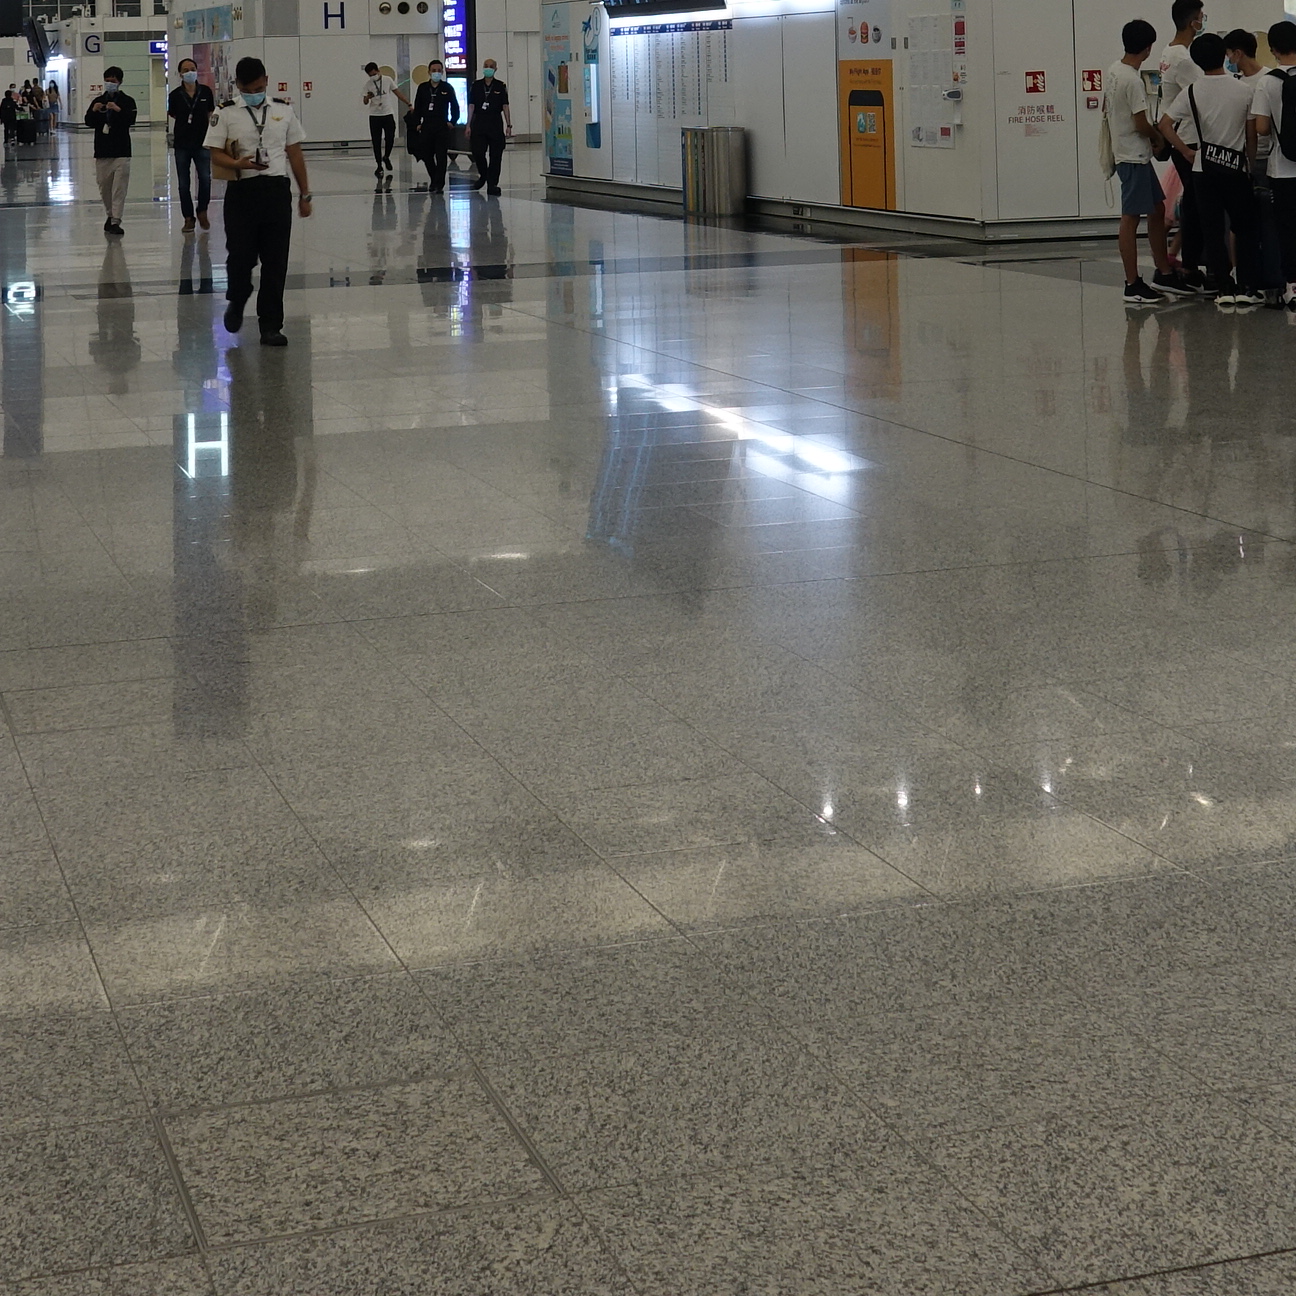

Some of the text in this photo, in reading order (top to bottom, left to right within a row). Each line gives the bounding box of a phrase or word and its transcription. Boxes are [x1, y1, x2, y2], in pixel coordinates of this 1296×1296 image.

[324, 1, 345, 29] H
[85, 34, 101, 53] G
[1008, 114, 1065, 124] FIRE HOSE REEL
[1206, 144, 1233, 163] PLAN
[1232, 154, 1240, 166] A
